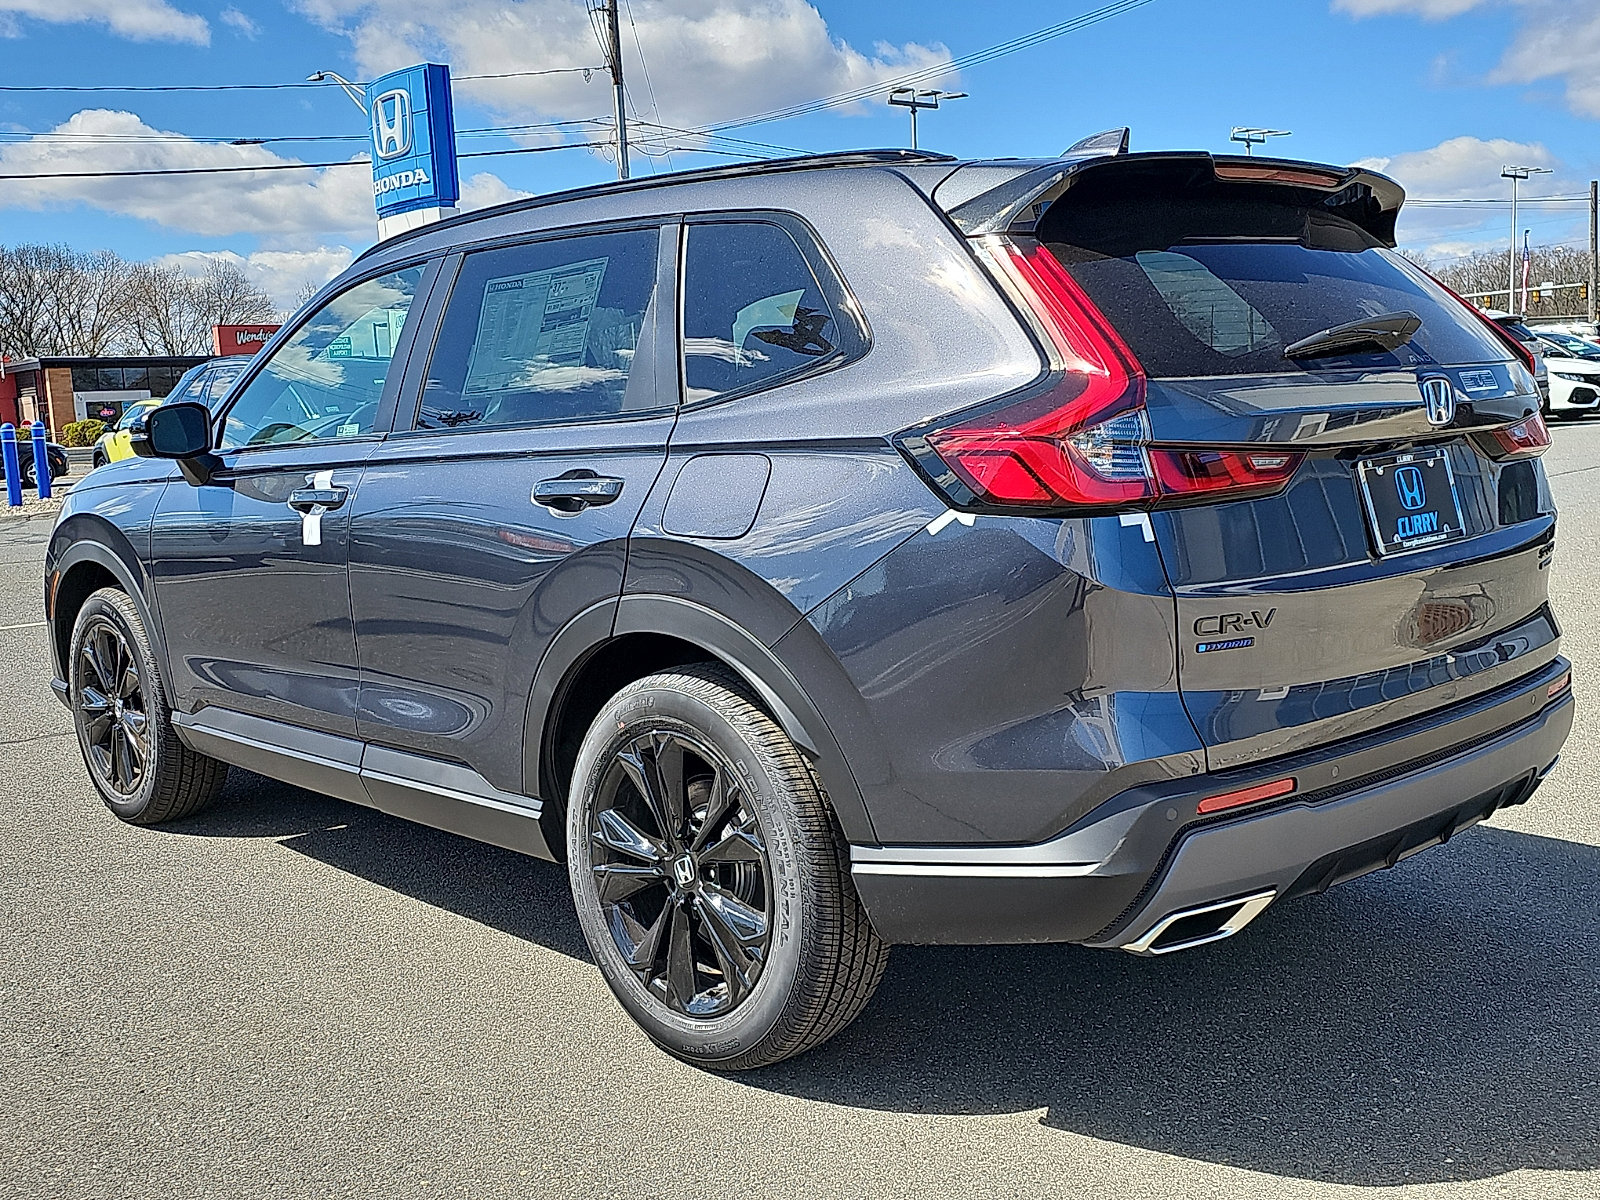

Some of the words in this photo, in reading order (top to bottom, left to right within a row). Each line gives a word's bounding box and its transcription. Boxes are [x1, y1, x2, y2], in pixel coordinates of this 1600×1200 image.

[373, 168, 430, 196] HONDA
[494, 281, 523, 291] HONDA
[236, 328, 274, 345] Wendy's
[1396, 454, 1414, 463] CURRY
[1397, 511, 1438, 537] CURRY
[1193, 607, 1277, 636] CR-V
[1206, 639, 1252, 651] HYBRID
[735, 757, 790, 949] CONTINENTAL
